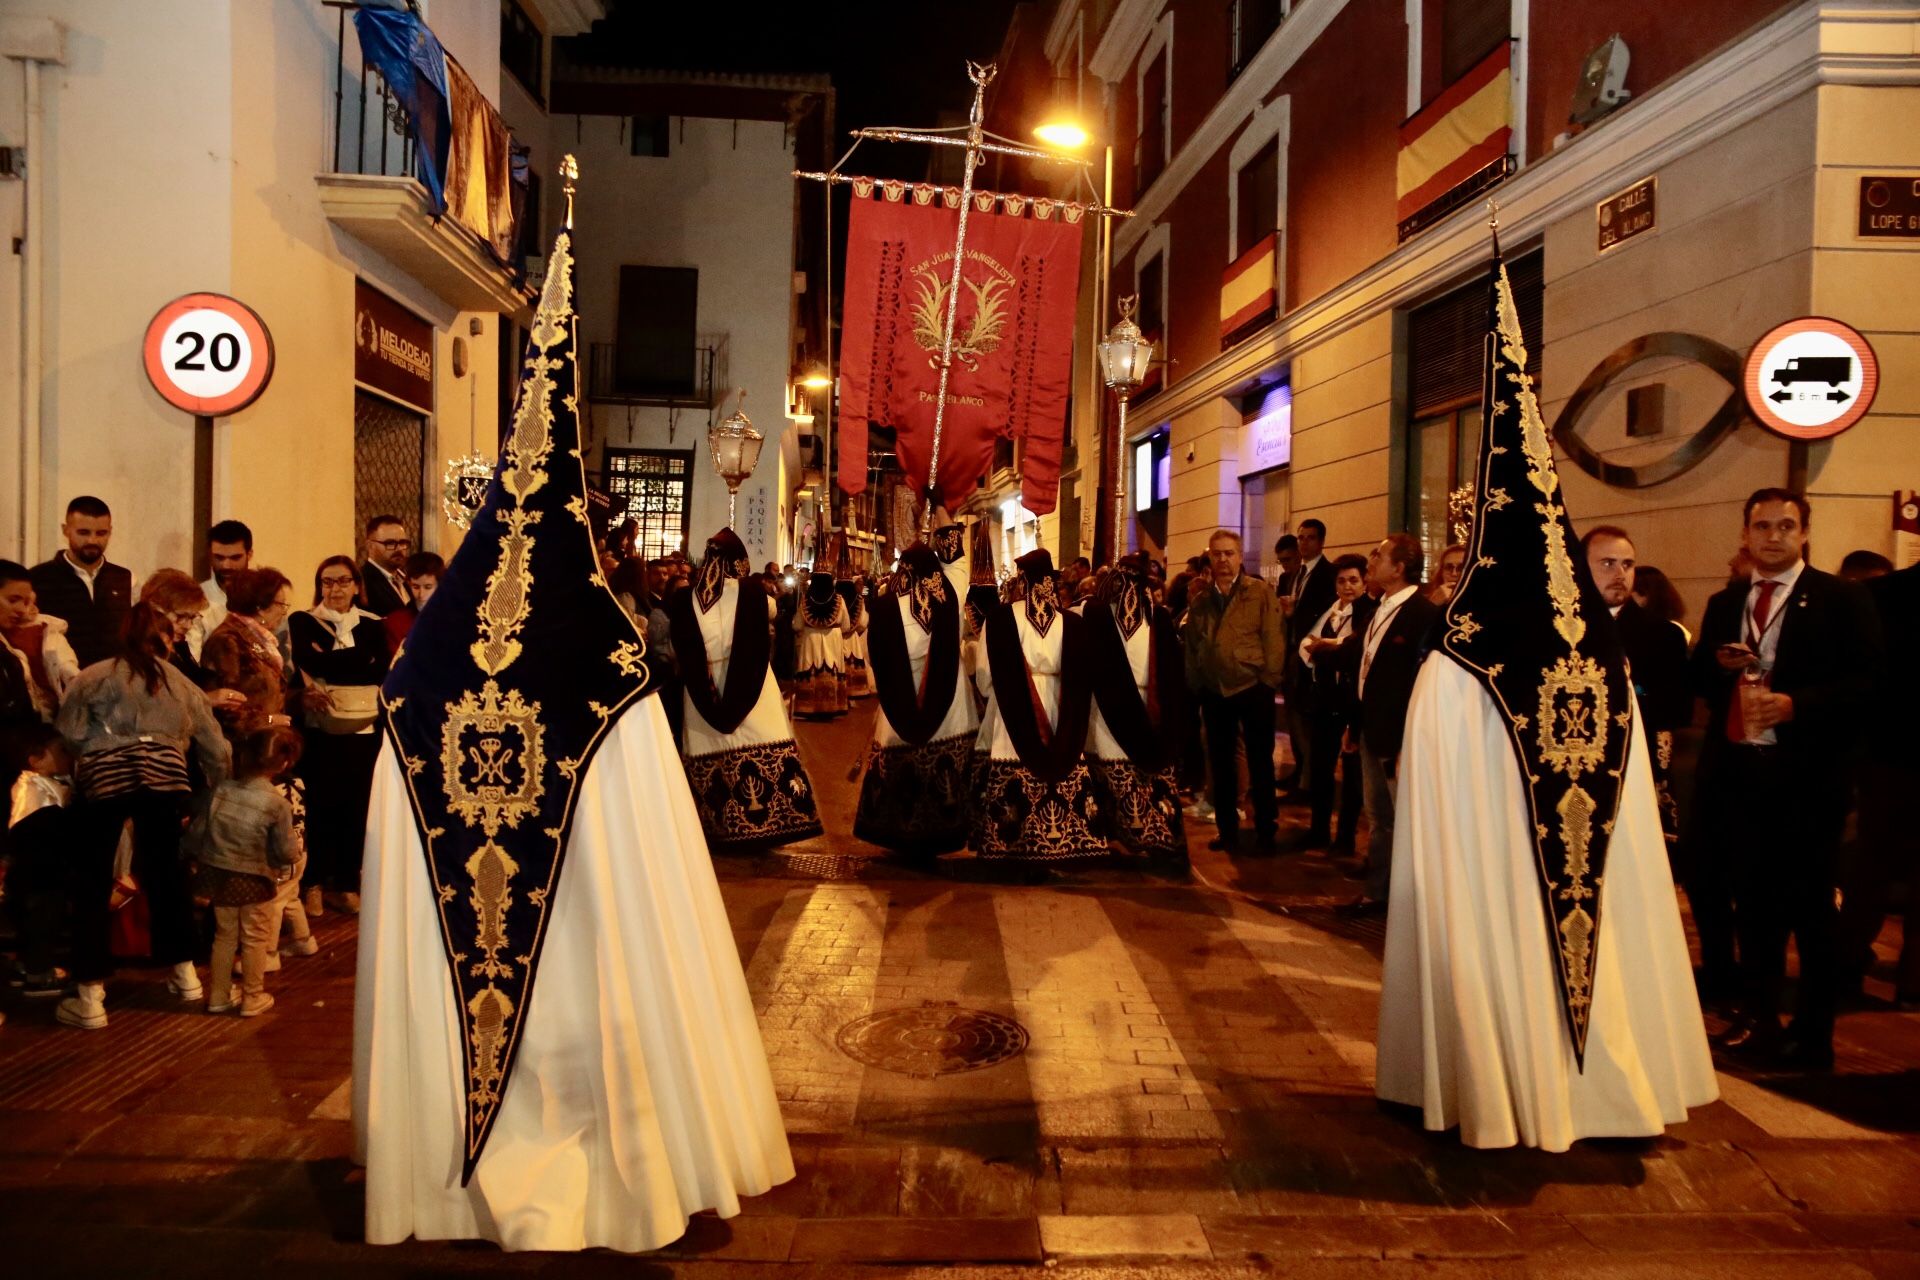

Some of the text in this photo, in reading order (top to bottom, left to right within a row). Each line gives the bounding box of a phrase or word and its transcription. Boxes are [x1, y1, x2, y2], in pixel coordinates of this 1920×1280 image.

[1619, 186, 1647, 212] CALLE
[1871, 215, 1920, 229] LOPE G
[1602, 229, 1617, 247] DEL
[909, 259, 930, 277] SAN
[962, 249, 1017, 288] VANGELISTA
[174, 331, 241, 372] 20
[380, 326, 431, 368] MELODEJO
[380, 348, 388, 360] TU
[388, 353, 407, 369] TIENDA
[407, 363, 415, 374] DE
[947, 394, 984, 407] BLANCO
[1799, 392, 1805, 401] 6
[757, 488, 765, 556] ESQUINA
